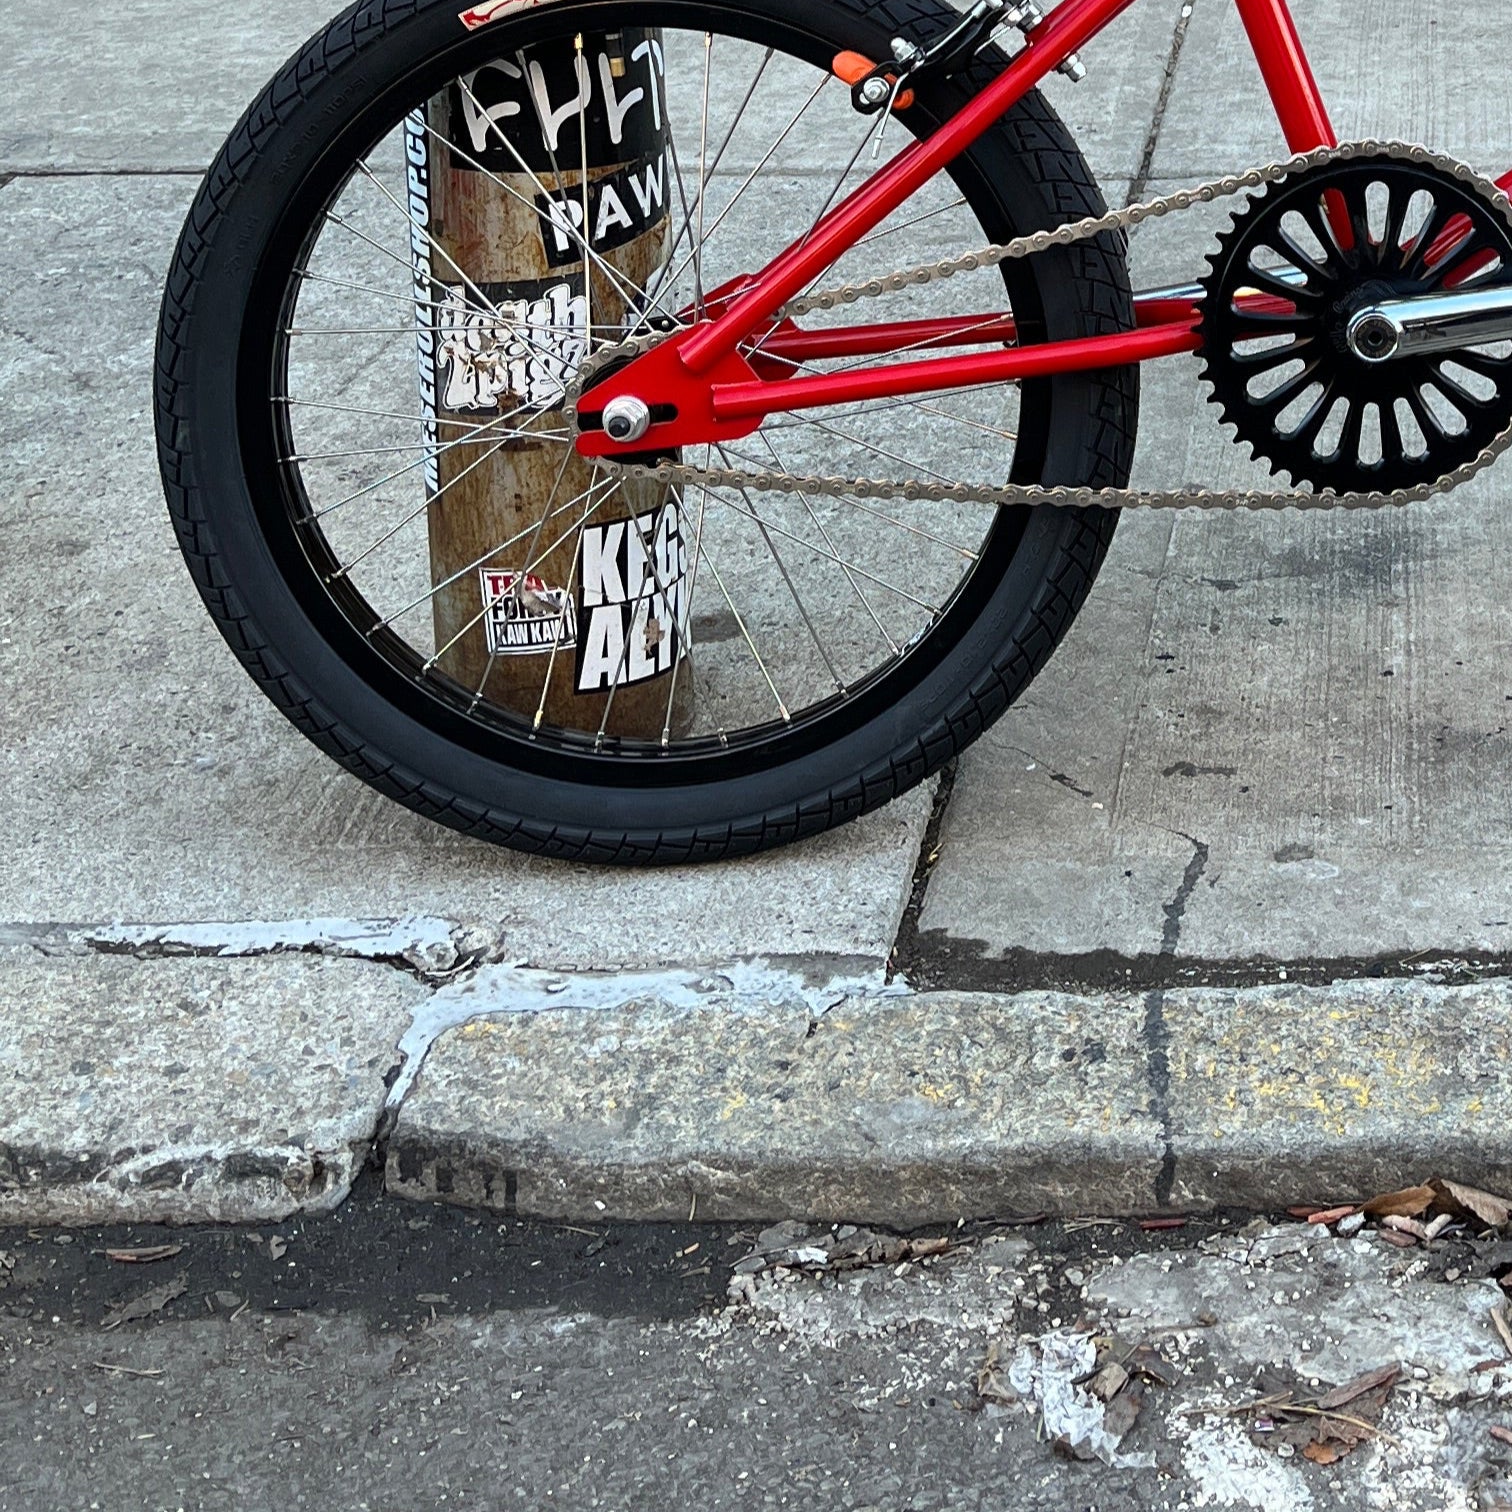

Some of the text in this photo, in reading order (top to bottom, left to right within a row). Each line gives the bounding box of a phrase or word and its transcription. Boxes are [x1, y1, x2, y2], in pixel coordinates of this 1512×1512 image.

[460, 39, 665, 154] CULT
[548, 152, 664, 252] PAW
[407, 102, 438, 492] MESEROLLSHOP.CO
[496, 619, 565, 645] KAW KAW
